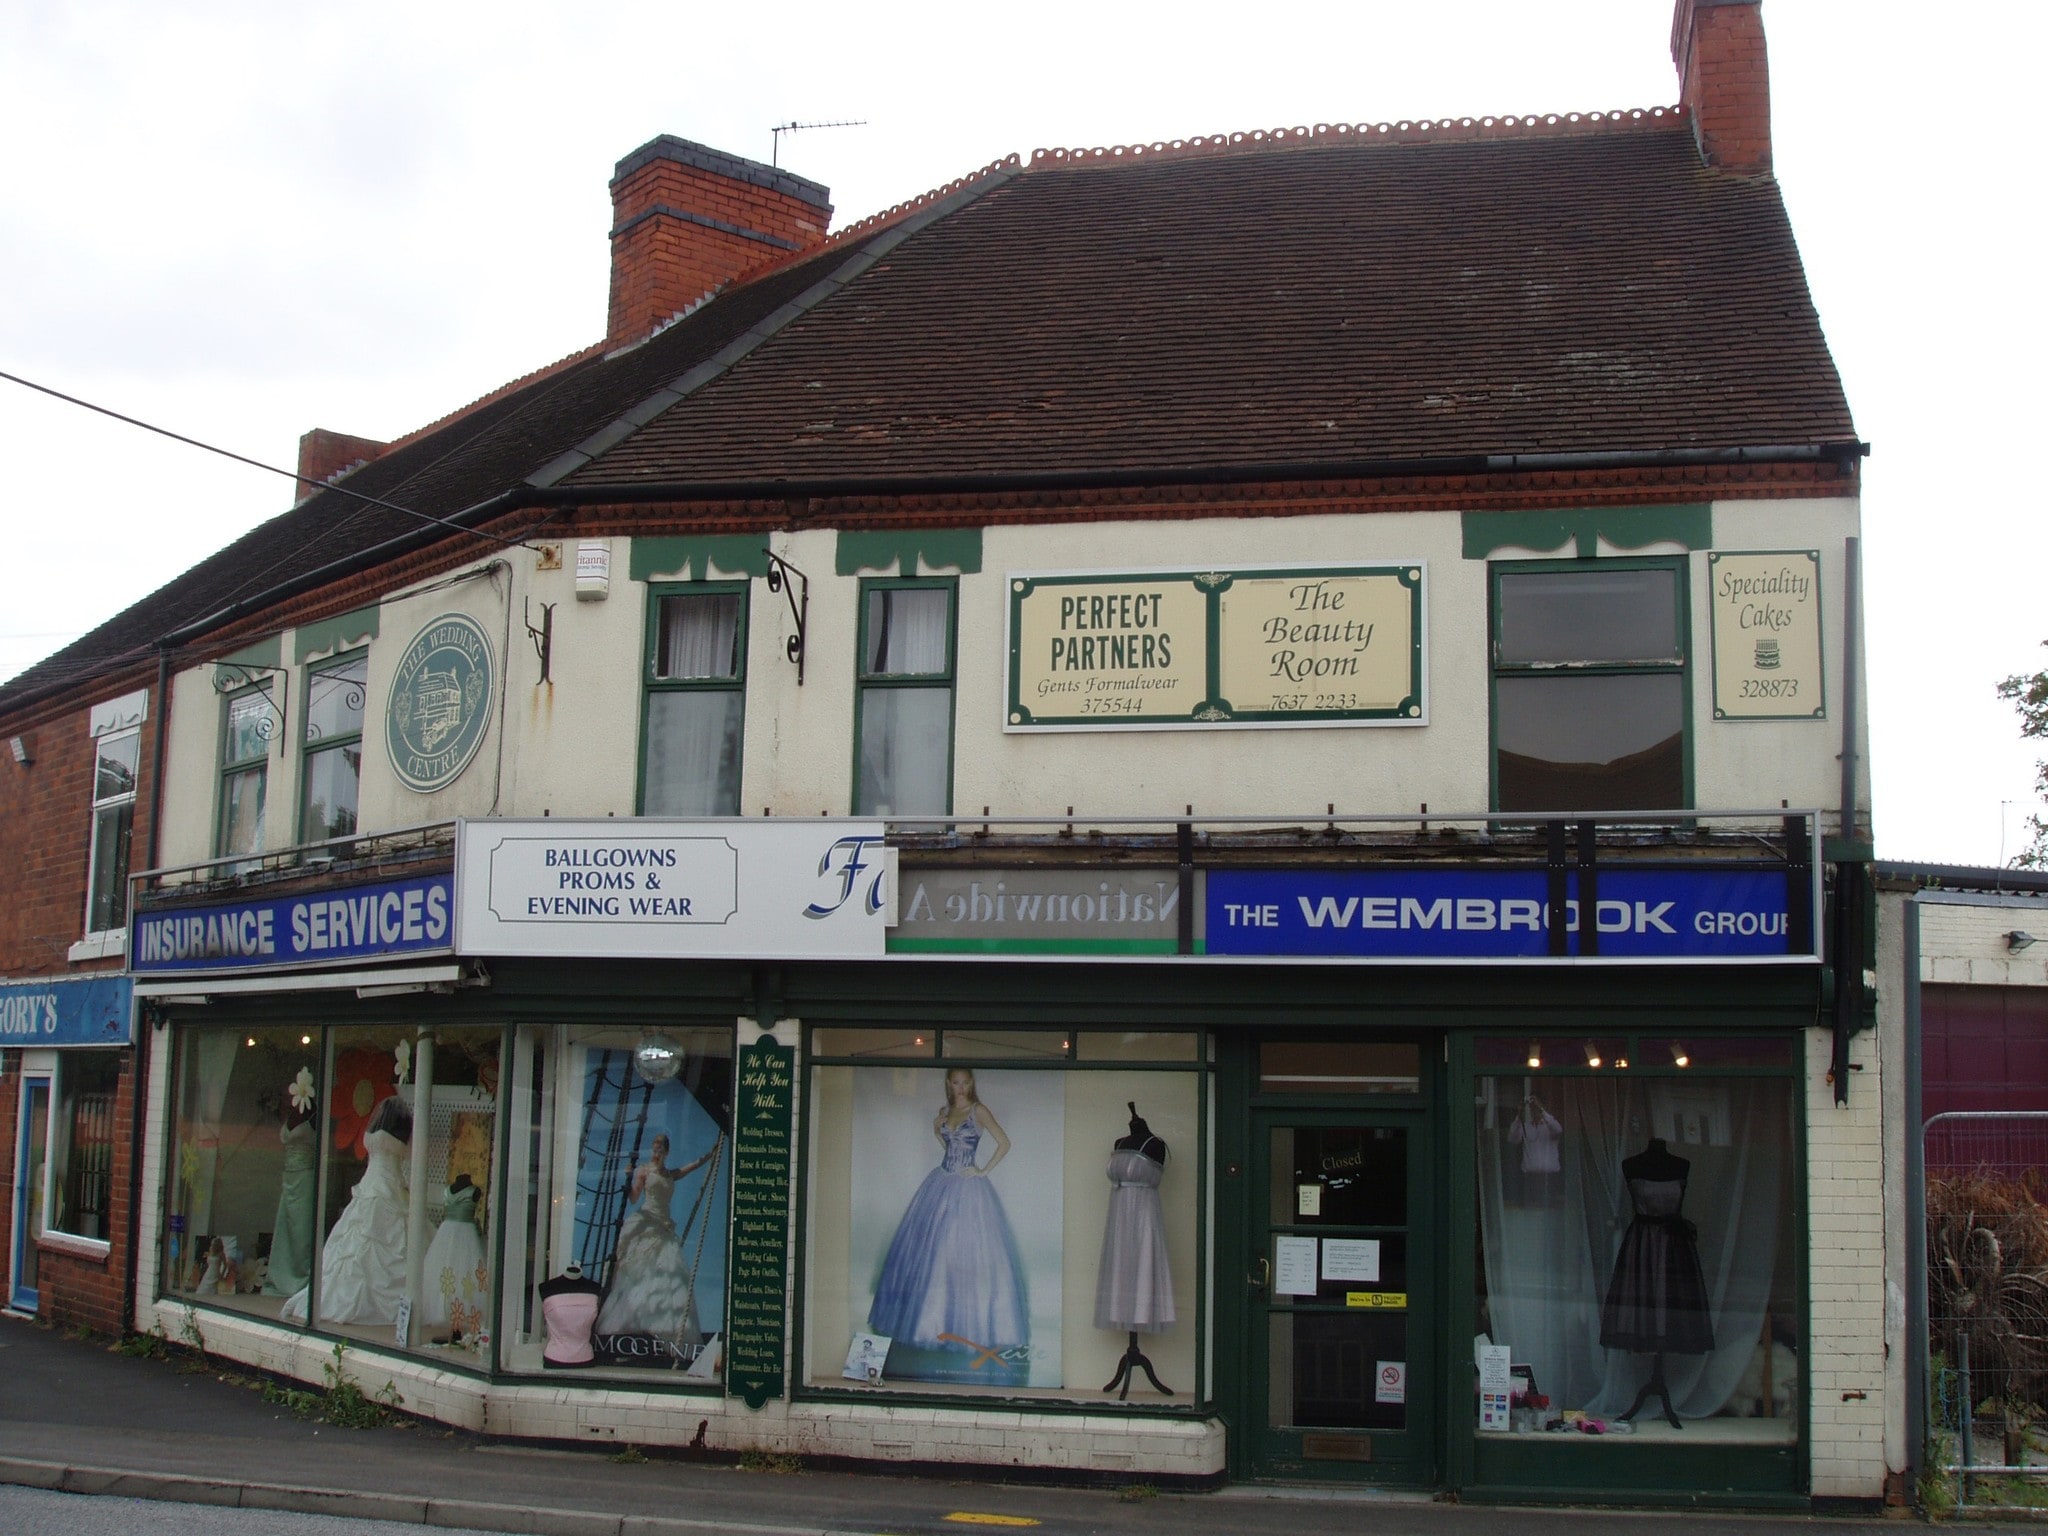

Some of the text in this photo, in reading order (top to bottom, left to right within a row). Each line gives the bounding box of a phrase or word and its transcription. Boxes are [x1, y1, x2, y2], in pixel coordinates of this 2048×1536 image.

[1290, 580, 1345, 612] The
[1719, 567, 1809, 603] Speciality
[1060, 593, 1162, 631] PERFECT
[1740, 602, 1792, 632] Cakes
[1263, 616, 1374, 652] Beauty
[401, 626, 482, 680] THE WEDDING
[1050, 633, 1171, 671] PARTNERS
[1269, 649, 1360, 682] Room
[1037, 675, 1179, 695] Gents Formalwear
[1738, 679, 1799, 698] 328873
[1080, 698, 1143, 714] 375544
[1271, 693, 1357, 711] 7637 2233
[407, 745, 460, 778] CENTRE
[545, 848, 677, 868] BALLGOWNS
[559, 872, 662, 890] PROMS &
[527, 898, 692, 916] EVENING WEAR
[1224, 904, 1279, 927] THE
[141, 885, 448, 961] INSURANCE SERVICES
[0, 993, 58, 1036] ORY'S
[746, 1054, 786, 1069] We Can
[742, 1072, 789, 1091] Help You
[742, 1127, 763, 1138] Wedding
[1323, 1151, 1362, 1171] Closed
